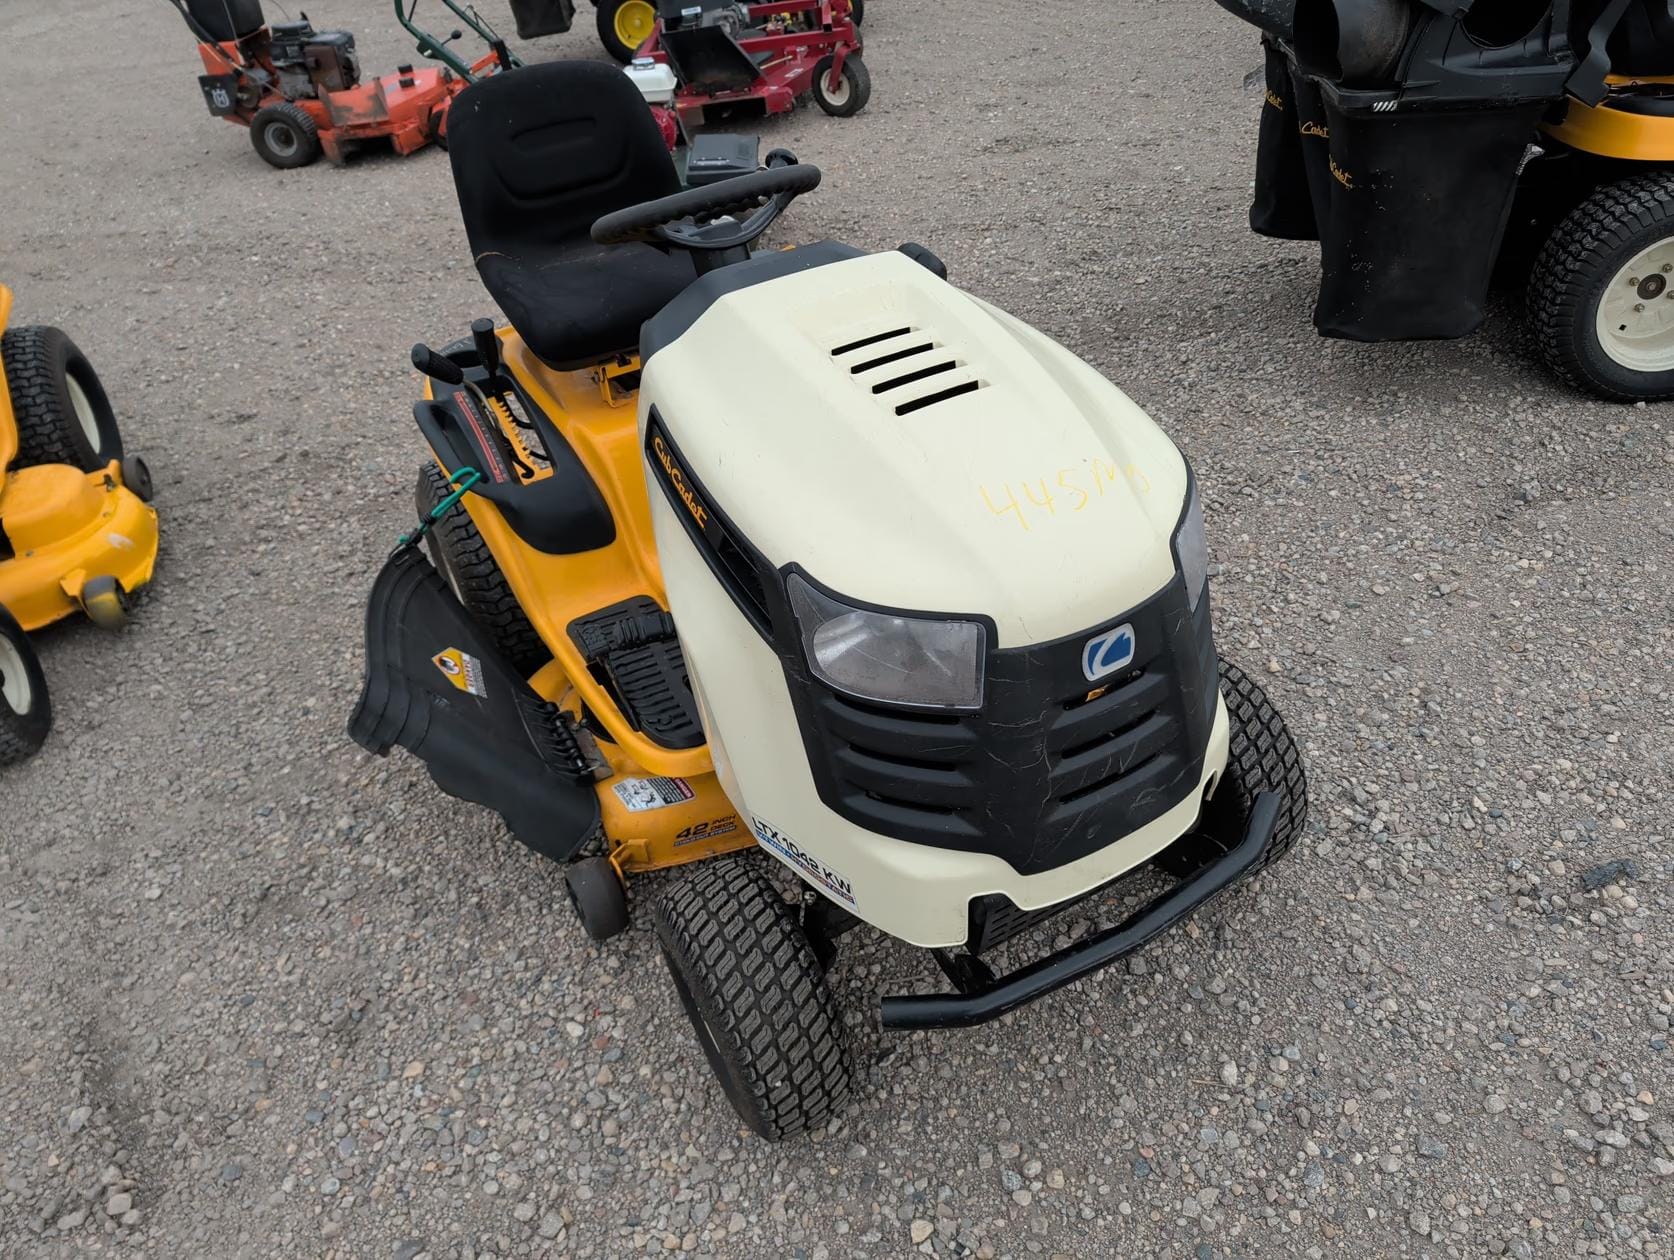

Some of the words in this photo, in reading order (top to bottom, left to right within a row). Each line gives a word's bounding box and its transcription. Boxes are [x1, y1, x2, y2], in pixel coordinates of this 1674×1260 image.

[1301, 121, 1329, 138] Cadet
[654, 436, 672, 475] Cub
[671, 467, 707, 529] Cadet
[676, 822, 709, 839] 42
[752, 816, 782, 844] LTX
[782, 837, 821, 875] 1042
[822, 867, 852, 894] KW
